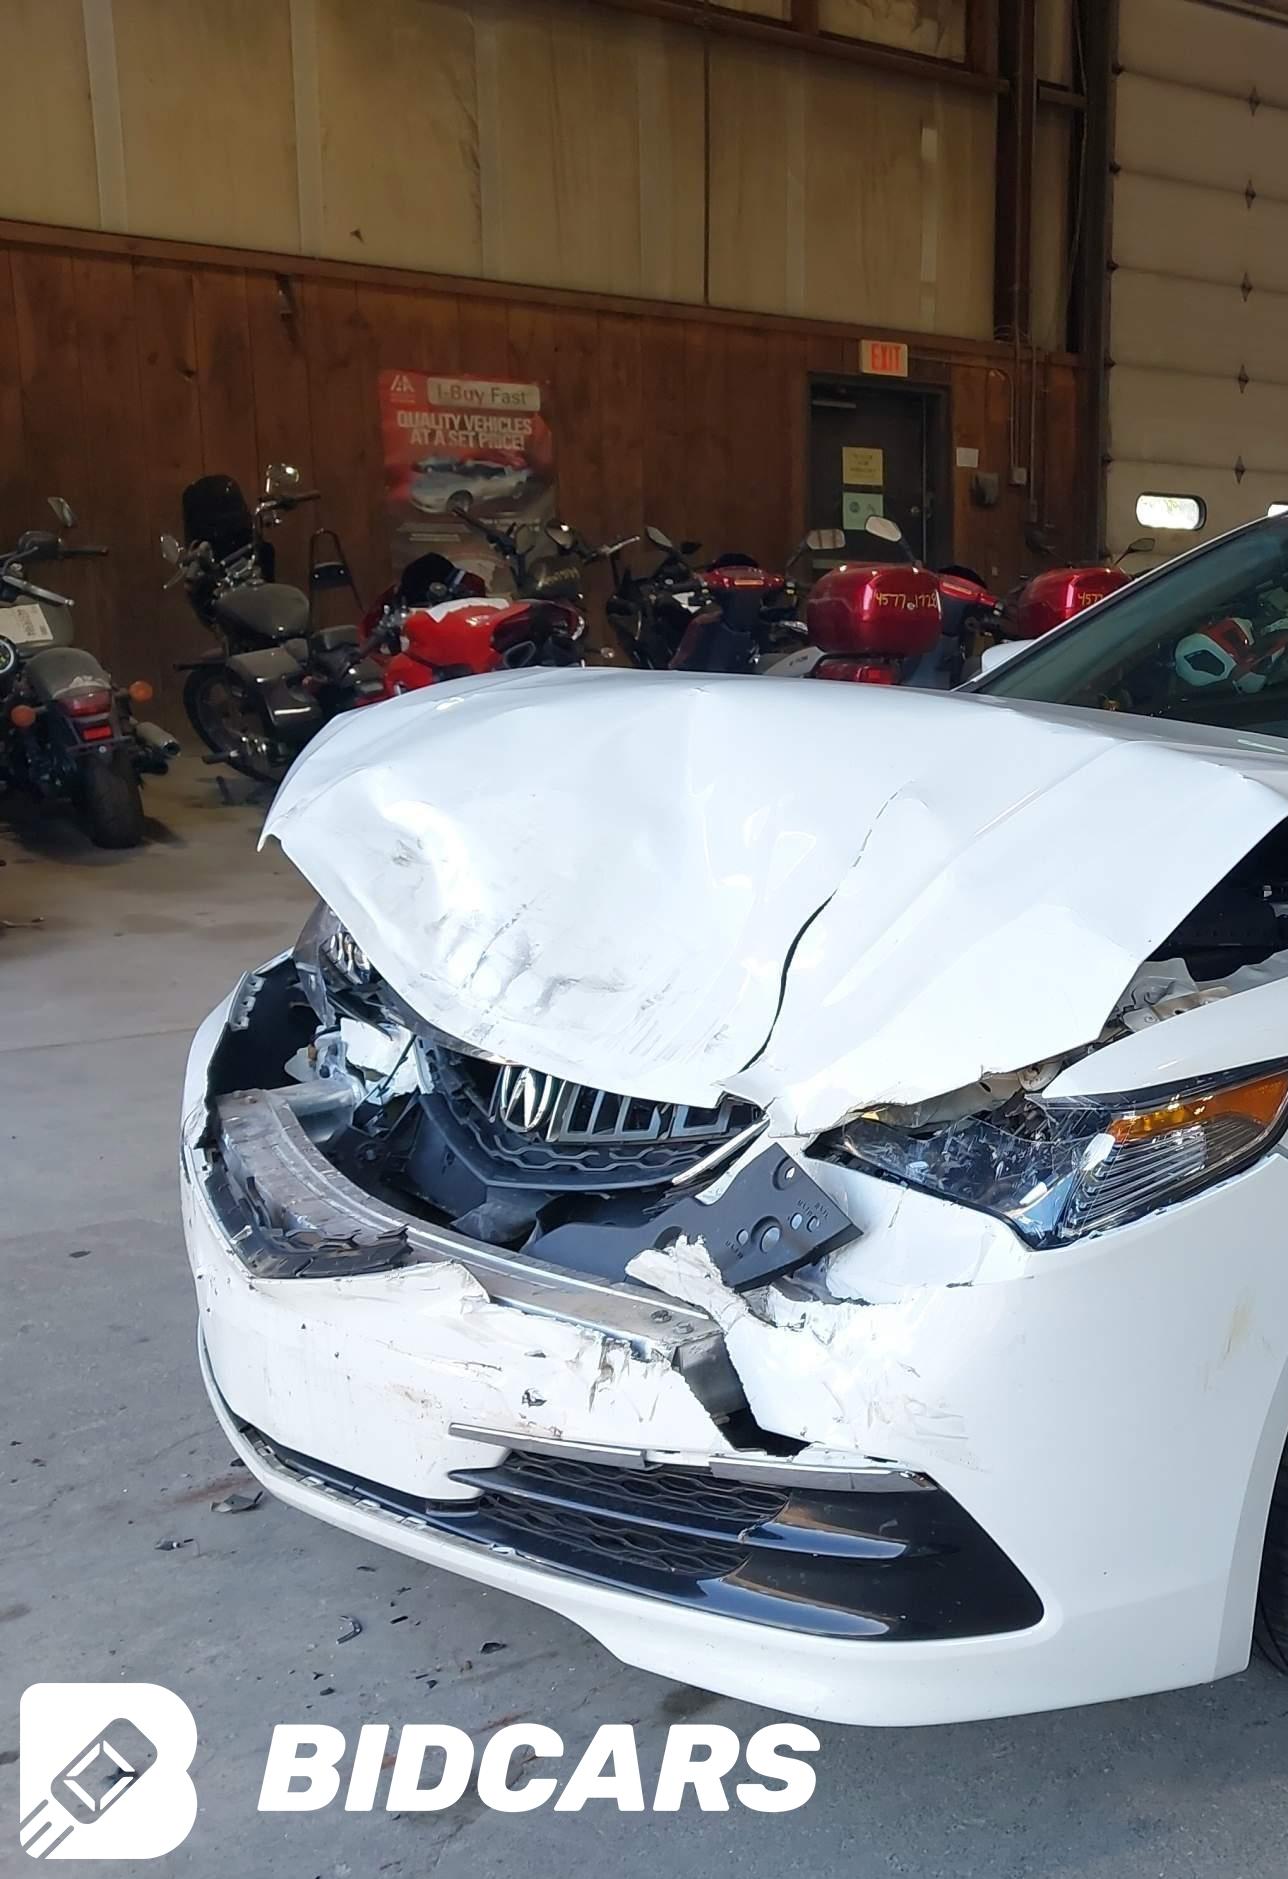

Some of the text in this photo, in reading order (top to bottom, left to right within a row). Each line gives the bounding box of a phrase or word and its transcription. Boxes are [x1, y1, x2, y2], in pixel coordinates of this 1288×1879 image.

[872, 343, 902, 371] EXIT
[437, 384, 486, 406] I-Buy
[490, 387, 527, 405] Fast
[396, 410, 532, 435] QUALITY VEHICLES
[410, 428, 526, 451] AT A SET PRICE!
